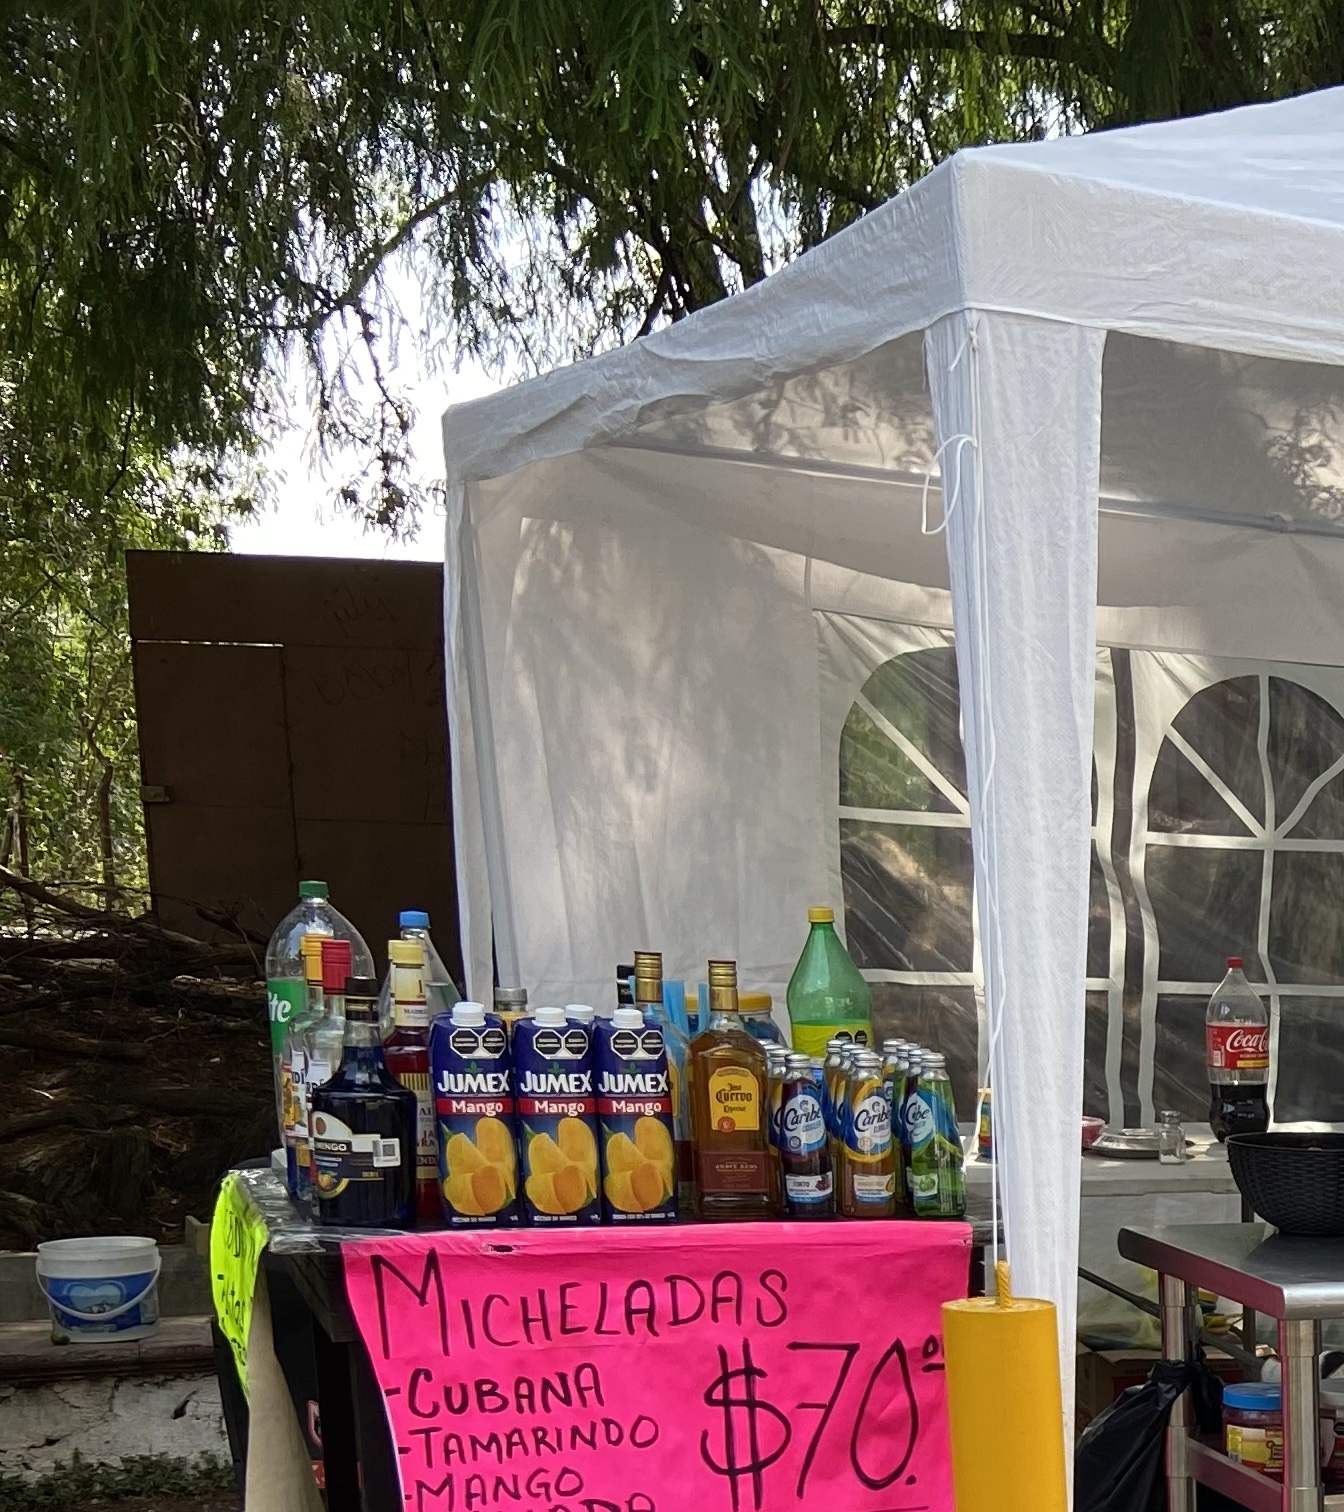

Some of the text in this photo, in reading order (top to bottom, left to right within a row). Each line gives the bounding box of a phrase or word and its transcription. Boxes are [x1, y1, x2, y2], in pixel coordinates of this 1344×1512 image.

[437, 1069, 511, 1093] JUMEX
[520, 1069, 592, 1093] JUMEX
[598, 1069, 669, 1093] JUMEX
[452, 1100, 503, 1116] Mango
[534, 1100, 585, 1116] Mango
[612, 1100, 662, 1116] Mango
[370, 1248, 788, 1358] MICHELADAS
